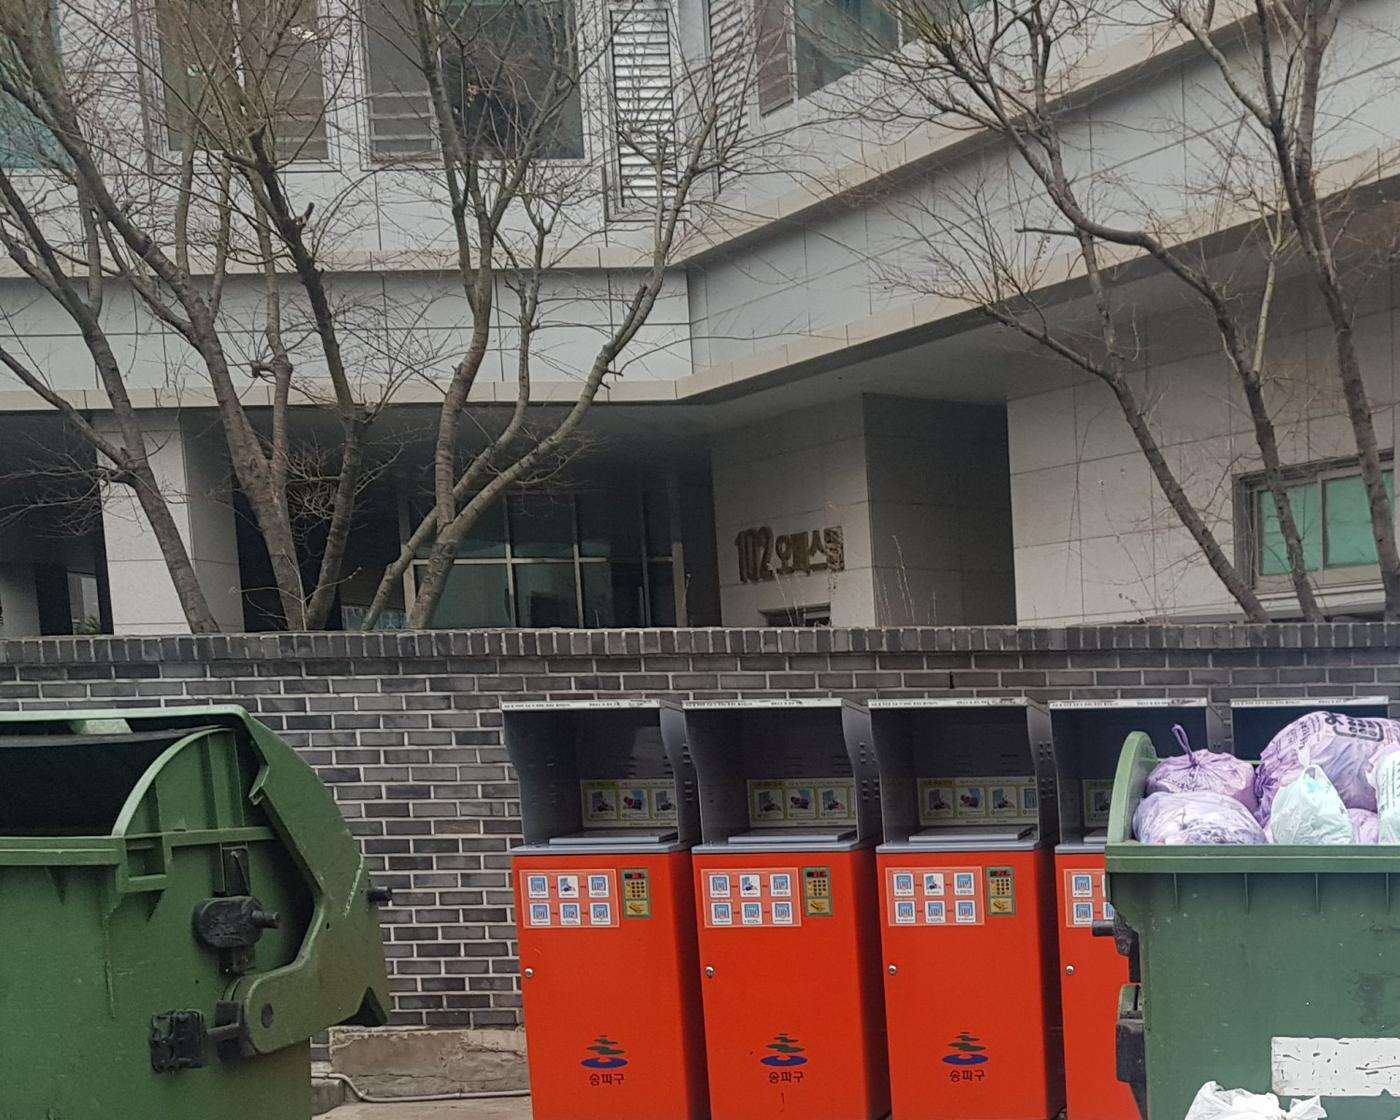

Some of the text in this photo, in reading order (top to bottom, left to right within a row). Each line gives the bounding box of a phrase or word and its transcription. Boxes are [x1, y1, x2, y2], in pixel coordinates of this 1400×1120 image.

[588, 1073, 625, 1086] 송파구
[769, 1071, 804, 1084] 송파구
[949, 1070, 985, 1083] 송파구
